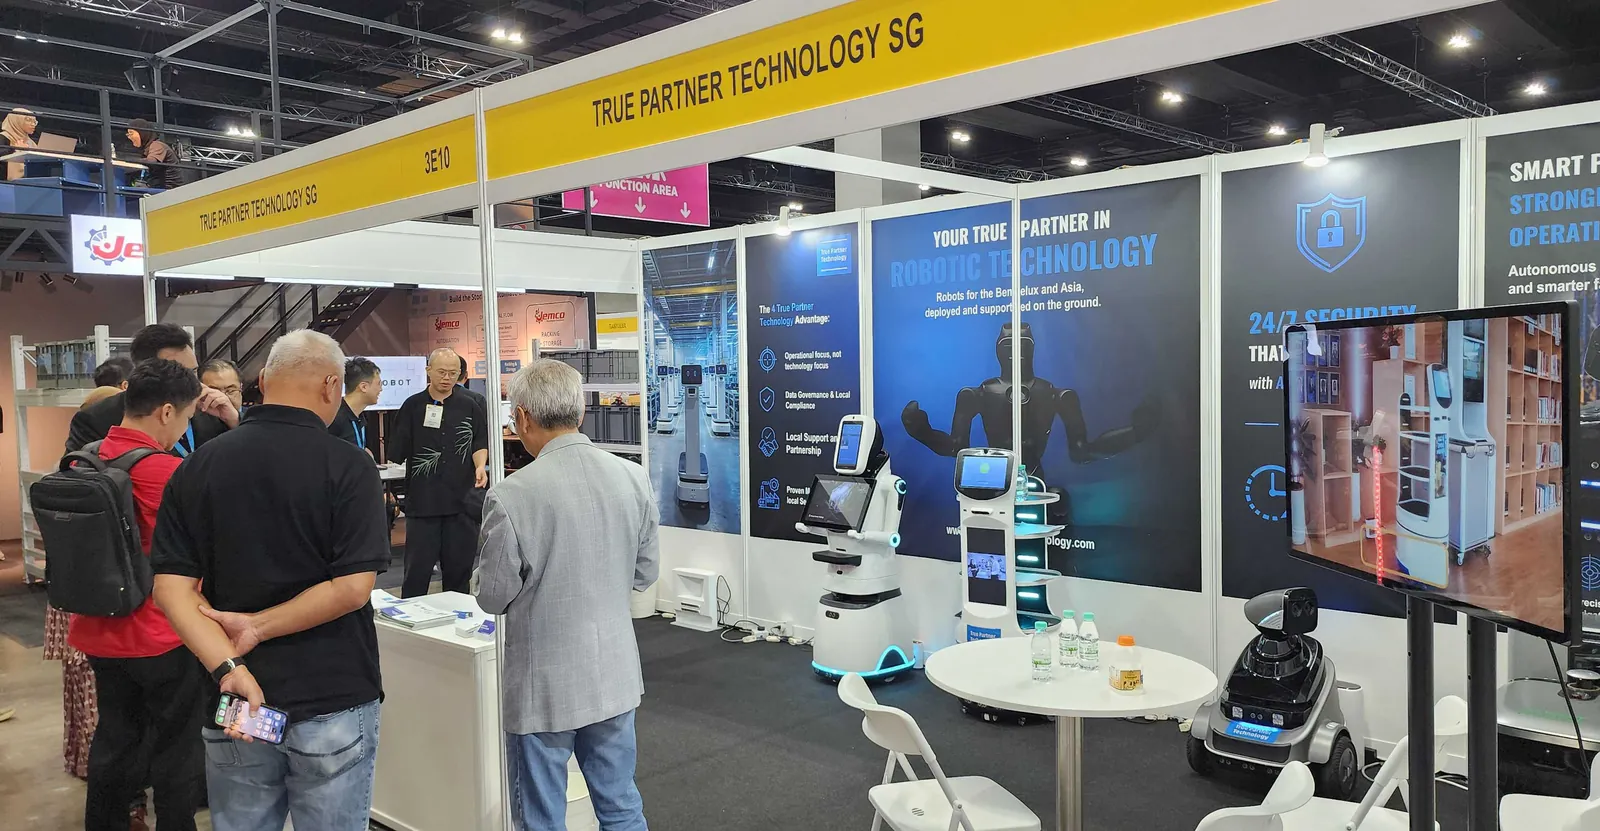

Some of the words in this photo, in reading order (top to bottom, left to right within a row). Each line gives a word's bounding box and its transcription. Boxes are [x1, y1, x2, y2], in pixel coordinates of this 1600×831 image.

[592, 92, 635, 127] TRUE
[640, 70, 724, 117] PARTNER
[728, 23, 881, 96] TECHNOLOGY
[888, 12, 924, 53] SG
[424, 146, 451, 174] 3E10
[1509, 154, 1584, 183] SMART
[600, 180, 651, 194] UNCTION
[652, 184, 679, 197] AREA
[199, 211, 217, 232] TRUE
[218, 202, 250, 227] PARTNER
[250, 188, 303, 218] TECHNOLOGY
[305, 184, 318, 206] SG
[933, 228, 969, 248] YOUR
[972, 222, 1008, 244] TRUE
[1020, 212, 1089, 239] PARTNER
[1093, 209, 1111, 230] IN
[1509, 221, 1600, 247] OPERATI
[820, 255, 847, 263] Technology
[890, 252, 981, 288] ROBOTIC
[988, 233, 1158, 279] TECHNOLOGY
[1508, 262, 1597, 277] Autonomous
[936, 291, 965, 302] Robots
[966, 289, 979, 300] for
[980, 288, 993, 299] the
[1041, 283, 1059, 295] and
[1060, 281, 1085, 294] Asia,
[1508, 281, 1533, 294] and
[1536, 280, 1590, 293] smarter
[759, 304, 771, 314] The
[771, 304, 776, 312] 4
[776, 303, 791, 313] True
[791, 302, 814, 312] Partner
[924, 305, 961, 319] deployed
[962, 304, 978, 315] and
[979, 301, 1031, 316] supported
[1033, 301, 1045, 311] on
[1047, 299, 1062, 310] the
[1064, 296, 1102, 311] ground.
[536, 310, 565, 322] Jemco
[759, 316, 794, 327] Technology
[794, 315, 831, 325] Advantage:
[1249, 310, 1298, 335] 24/7
[436, 319, 460, 330] Jemco
[784, 351, 814, 361] Operational
[814, 350, 832, 359] focus,
[832, 350, 842, 358] not
[784, 362, 813, 371] technology
[813, 361, 829, 369] focus
[382, 379, 411, 387] OBOT
[1249, 375, 1273, 390] with
[785, 390, 798, 399] Data
[798, 391, 829, 399] Governance
[835, 390, 851, 399] Local
[785, 401, 816, 410] Compliance
[786, 432, 803, 441] Local
[803, 432, 829, 443] Support
[829, 435, 838, 443] an
[786, 445, 822, 457] Partnership
[786, 485, 805, 495] Proven
[786, 496, 799, 505] local
[1233, 728, 1270, 741] Technology
